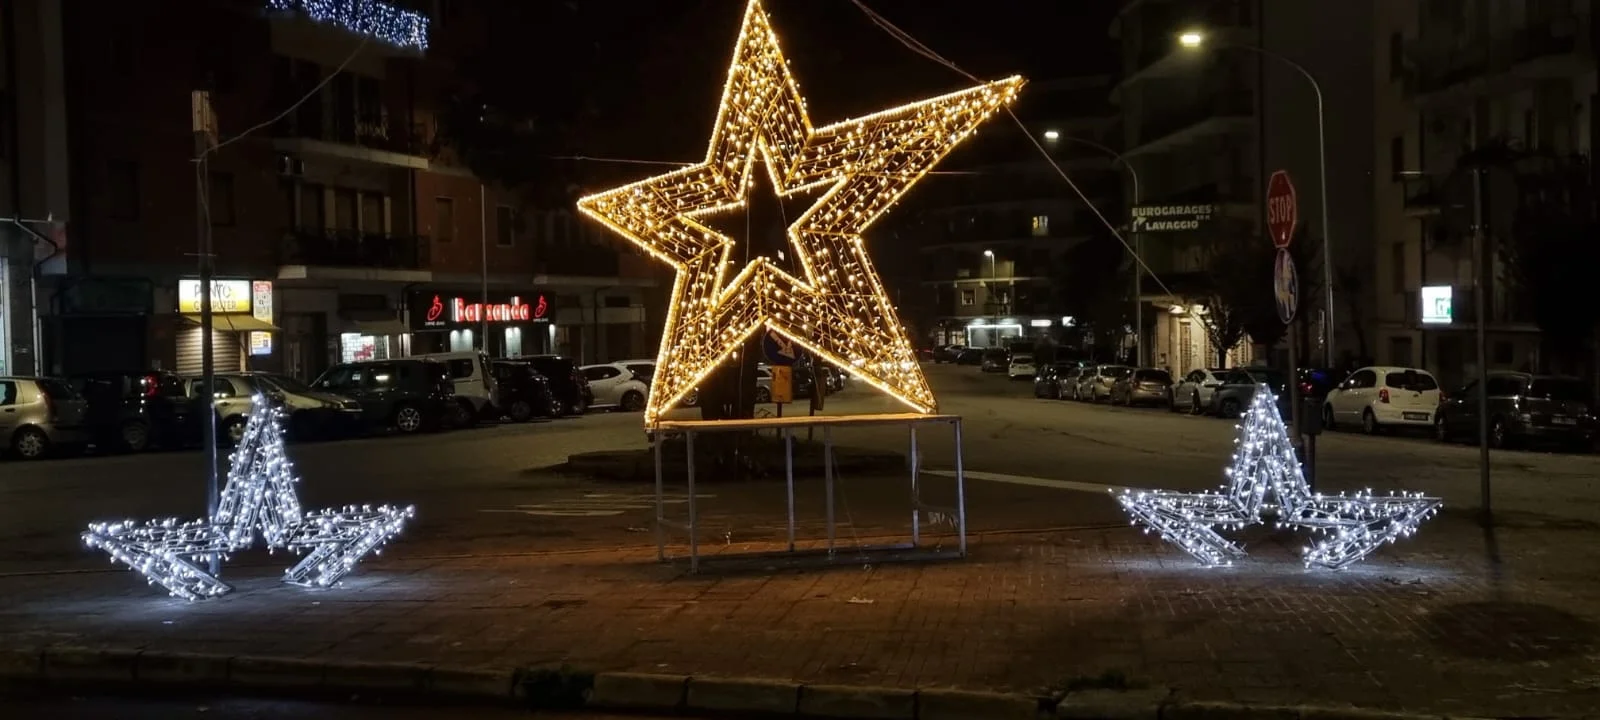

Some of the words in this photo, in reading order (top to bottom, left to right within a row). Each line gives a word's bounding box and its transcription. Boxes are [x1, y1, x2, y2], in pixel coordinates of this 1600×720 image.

[1132, 204, 1212, 216] EUROGARAGES
[1269, 195, 1292, 223] STOP
[1146, 220, 1199, 231] LAVAGGIO
[194, 284, 232, 299] PNTO
[193, 301, 237, 311] CPUTER
